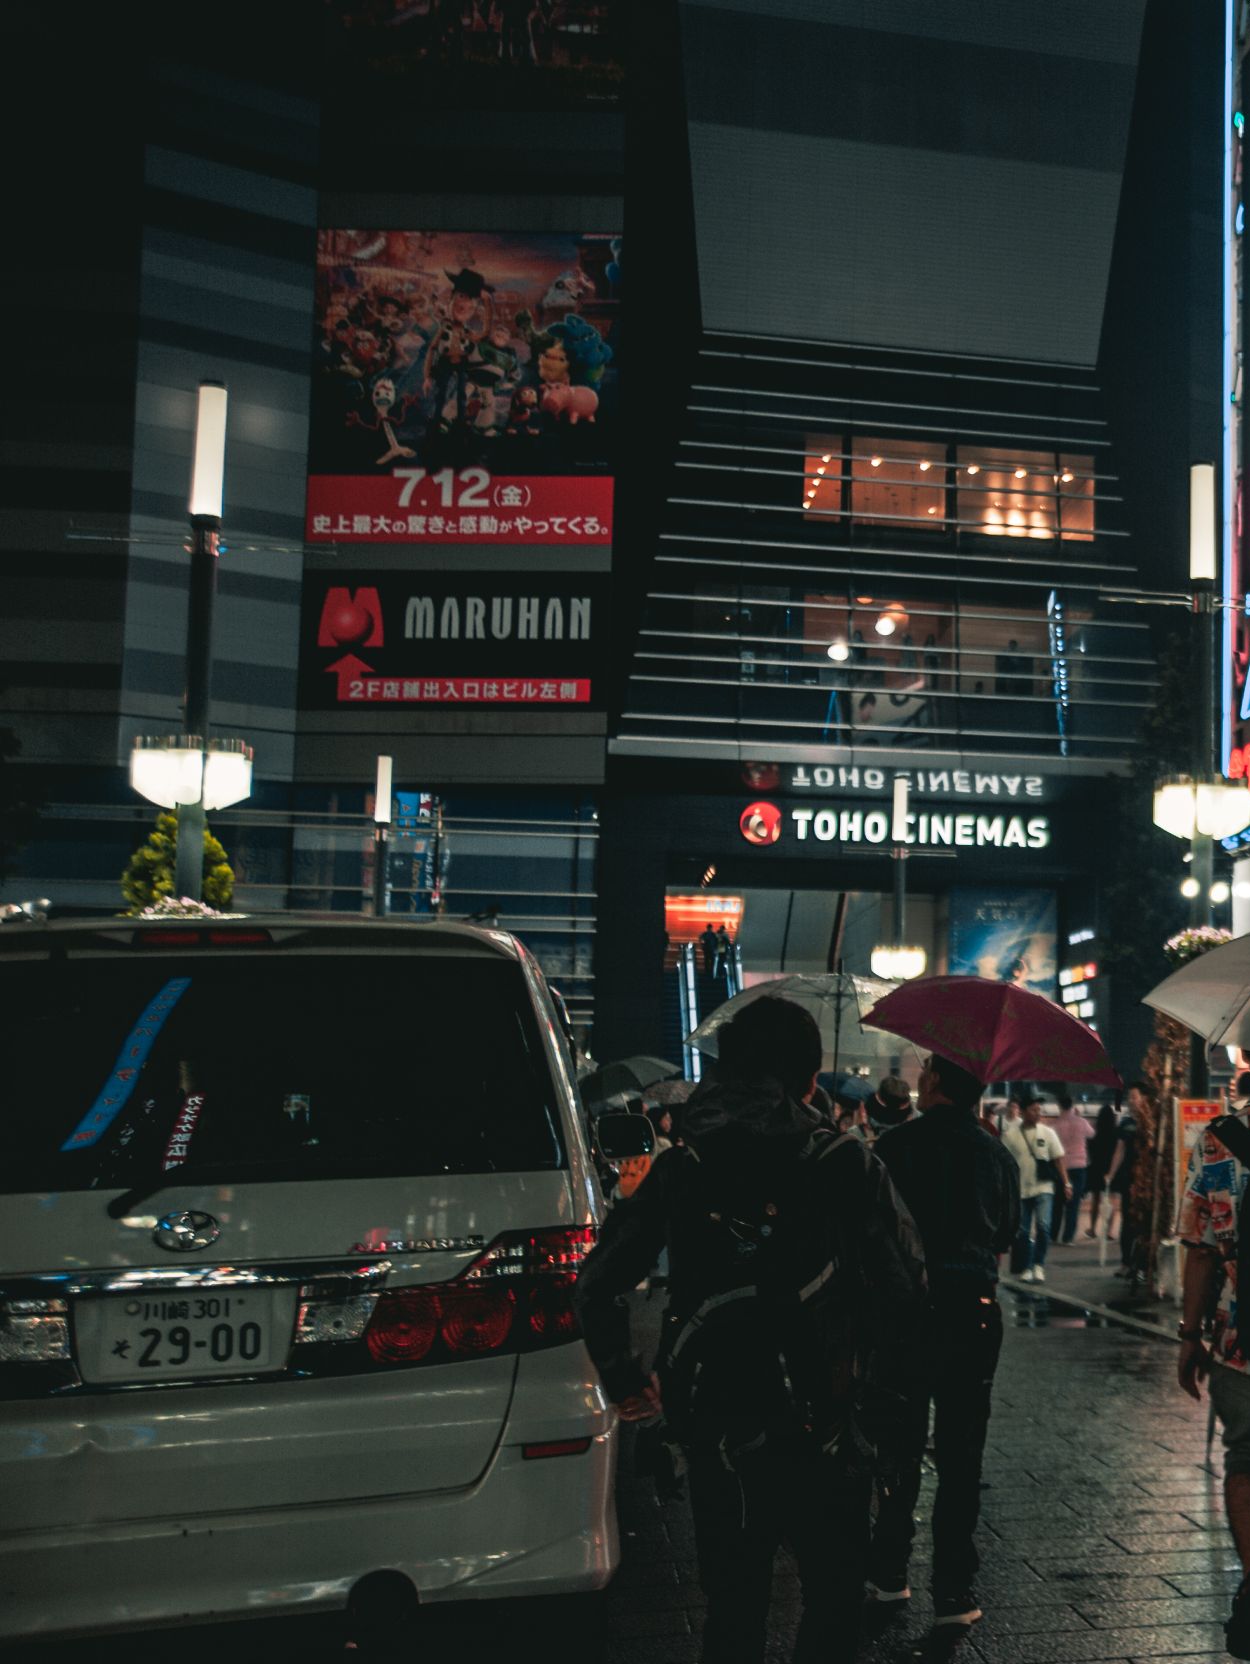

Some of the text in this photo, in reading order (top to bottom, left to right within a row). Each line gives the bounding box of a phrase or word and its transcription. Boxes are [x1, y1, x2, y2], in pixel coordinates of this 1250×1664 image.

[311, 514, 609, 536] 史上最大の驚きと感動がやってくる。
[404, 596, 592, 640] MARUHAN
[349, 680, 578, 701] 2F店舗出入口はビル左側
[791, 809, 889, 844] TOHO
[193, 1298, 230, 1319] 301
[138, 1321, 262, 1368] 29-00
